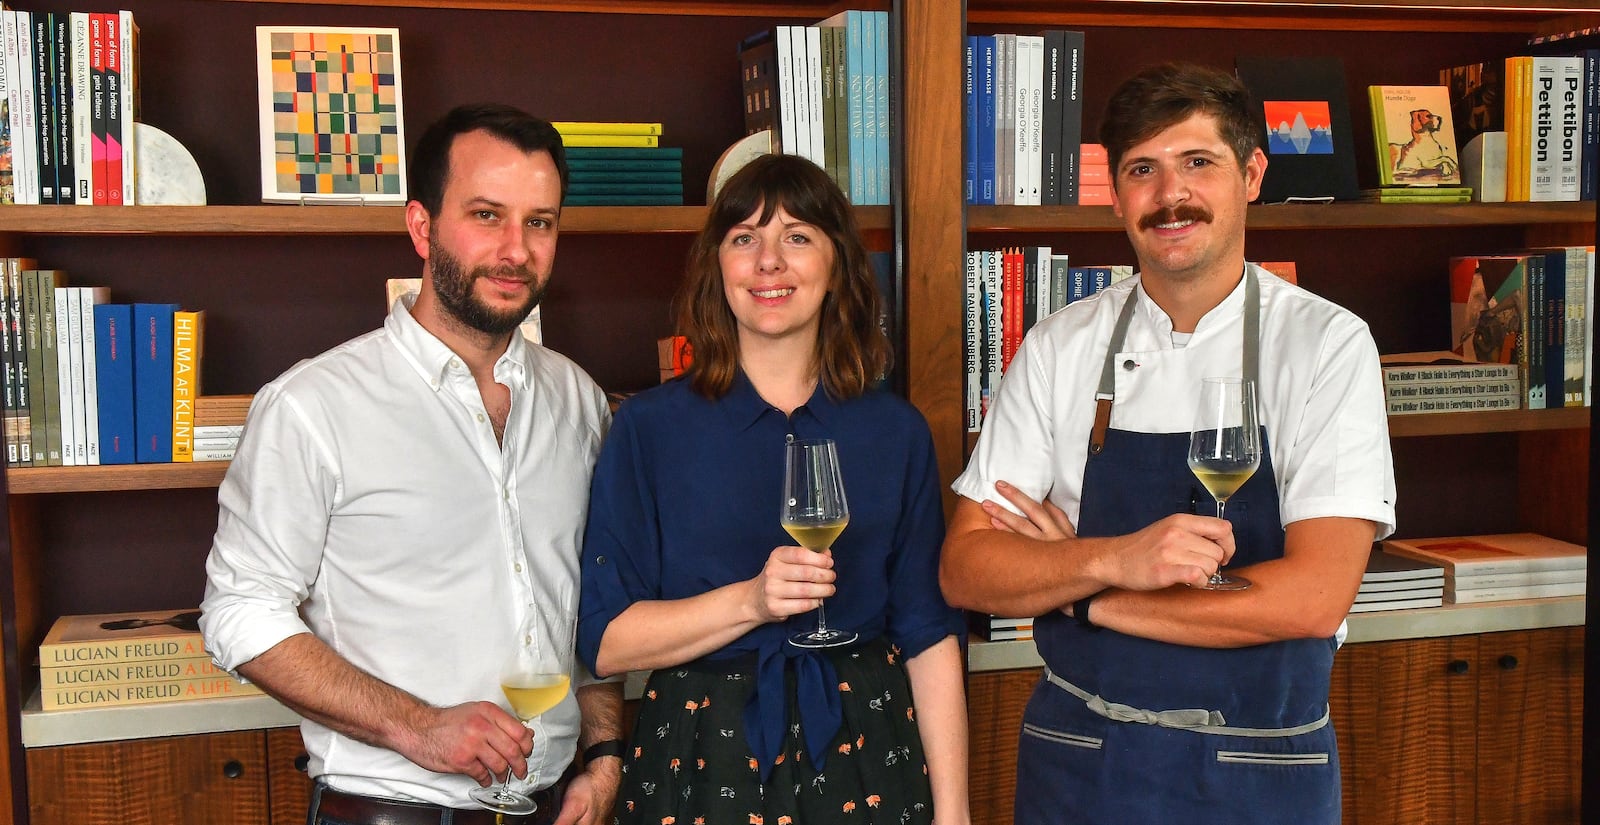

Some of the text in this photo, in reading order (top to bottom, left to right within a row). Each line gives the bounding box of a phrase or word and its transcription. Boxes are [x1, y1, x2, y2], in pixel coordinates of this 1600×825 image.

[91, 19, 99, 38] game
[106, 20, 114, 38] game
[94, 49, 102, 66] forms
[109, 49, 117, 67] forms
[77, 61, 85, 100] DRAWING
[92, 75, 101, 90] geta
[108, 75, 116, 90] geta
[1018, 88, 1027, 118] Georgia
[1032, 88, 1040, 119] Georgia
[1537, 77, 1553, 162] Pettibon
[1562, 78, 1578, 162] Pettibon
[1074, 272, 1082, 298] SOPHIE
[967, 251, 975, 374] ROBERT RAUSCHENBERG
[988, 251, 996, 373] ROBERT RAUSCHENBERG
[175, 319, 191, 449] HILMA AF KLINT
[55, 646, 119, 663] LUCIAN
[125, 642, 179, 658] FREUD
[184, 641, 195, 654] A
[56, 668, 120, 685] LUCIAN
[127, 664, 180, 680] FREUD
[185, 663, 196, 676] A
[57, 680, 232, 705] LUCIAN FREUD A LIFE
